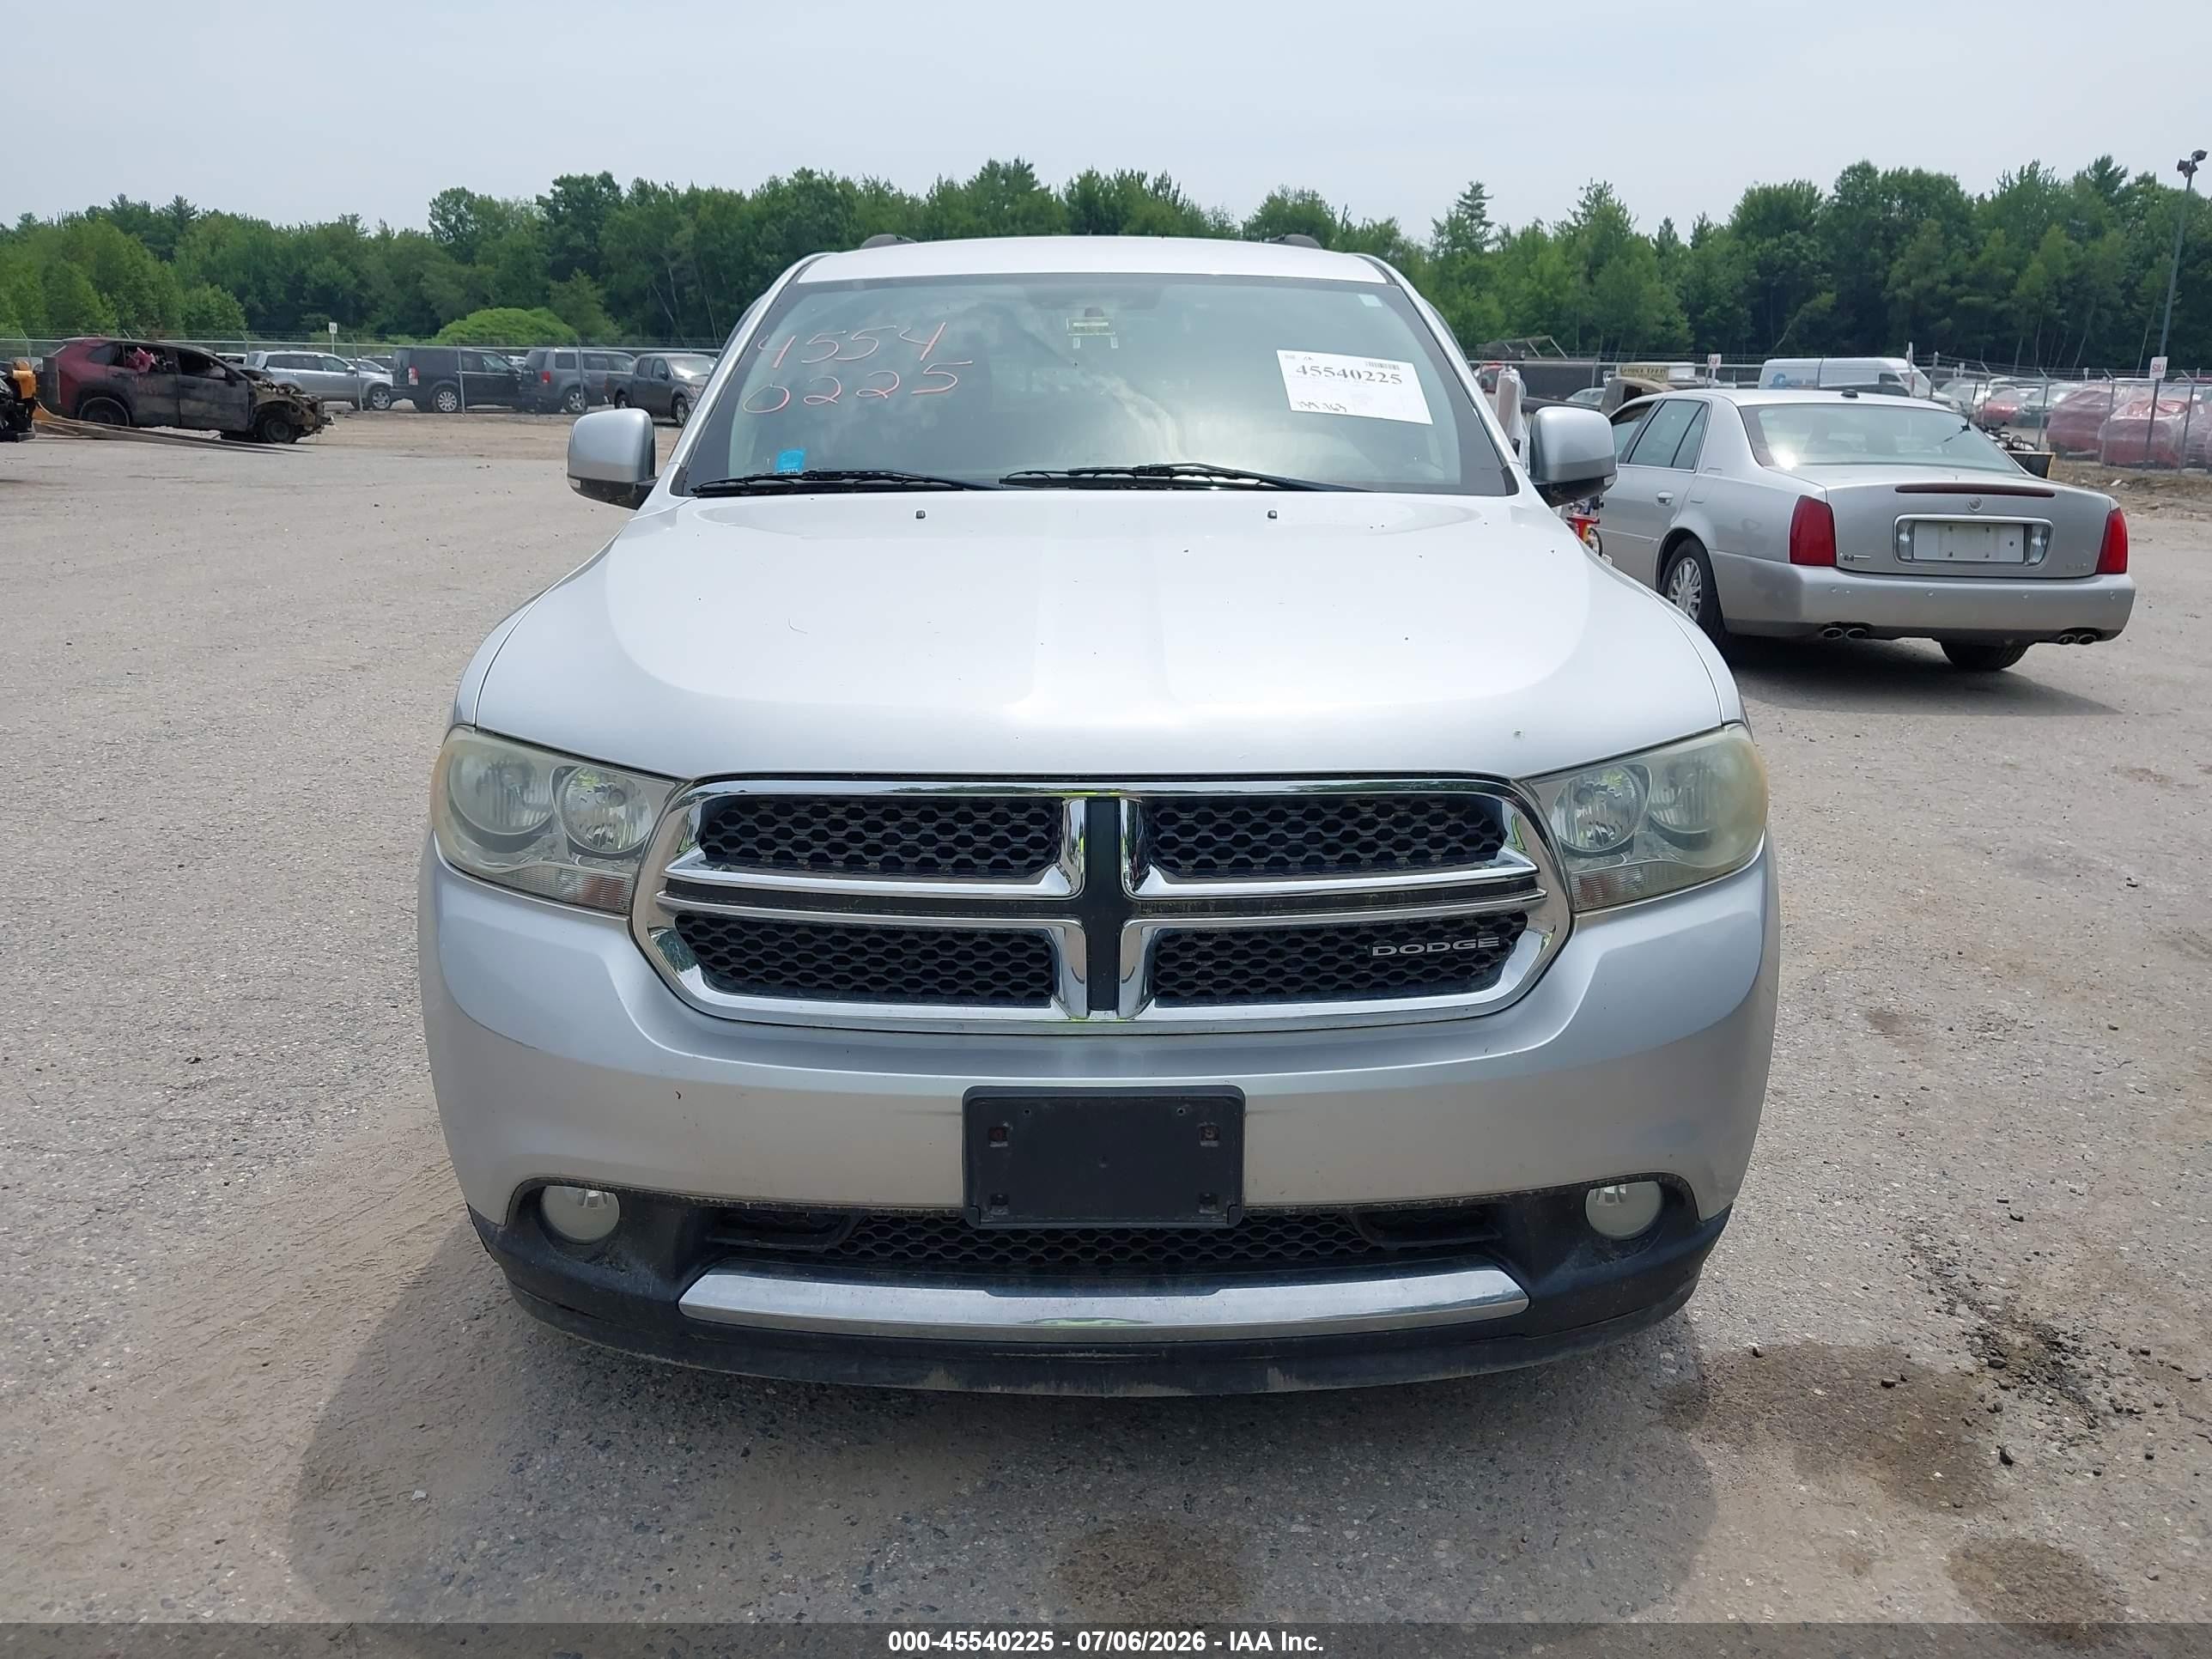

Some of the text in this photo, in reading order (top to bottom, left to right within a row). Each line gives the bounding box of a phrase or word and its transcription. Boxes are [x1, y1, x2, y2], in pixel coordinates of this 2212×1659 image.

[757, 321, 946, 368] 4554
[742, 360, 974, 414] 0225
[1295, 364, 1402, 385] 45540225
[1372, 937, 1500, 957] DODGE
